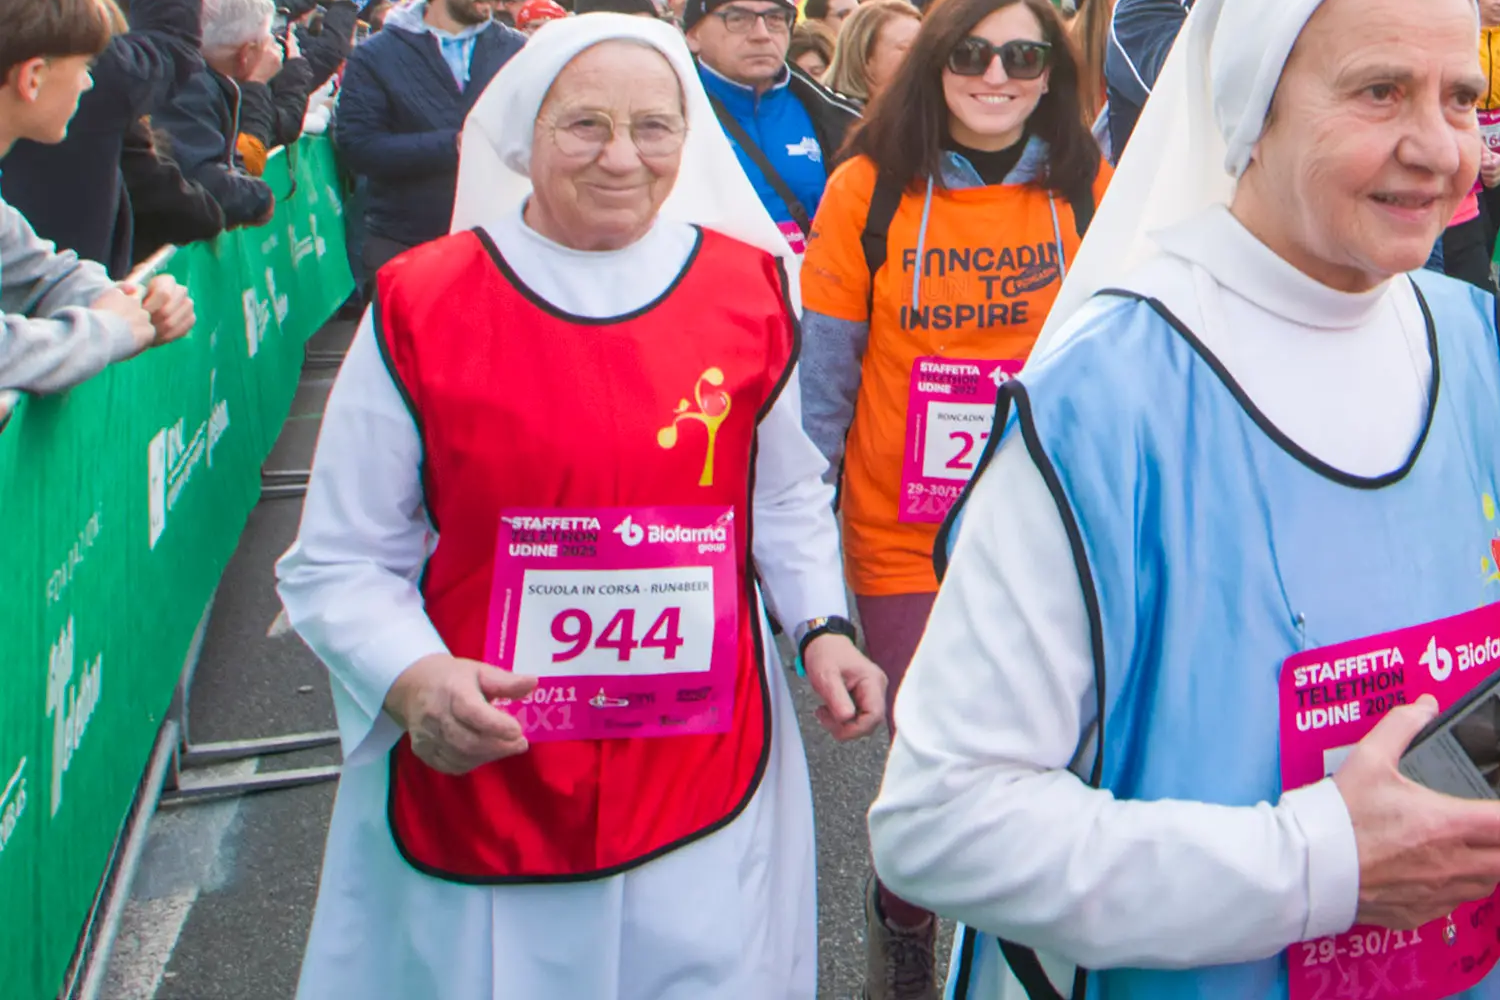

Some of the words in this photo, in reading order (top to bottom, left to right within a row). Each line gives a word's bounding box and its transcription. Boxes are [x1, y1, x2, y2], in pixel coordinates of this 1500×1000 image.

[900, 301, 1029, 330] INSPIRE
[920, 361, 980, 375] STAFFETTA
[918, 382, 951, 394] UDINE
[511, 517, 601, 531] STAFFETTA
[648, 525, 726, 543] Biofarma
[511, 532, 598, 543] TELETHON
[509, 543, 558, 557] UDINE
[698, 543, 726, 554] group
[528, 585, 578, 596] SCUOLA
[582, 585, 595, 595] IN
[598, 584, 641, 595] CORSA
[550, 606, 684, 663] 944
[1294, 647, 1404, 687] STAFFETTA
[1296, 667, 1404, 707] TELETHON
[1296, 701, 1360, 732] UDINE
[1302, 928, 1422, 967] 29-30/11
